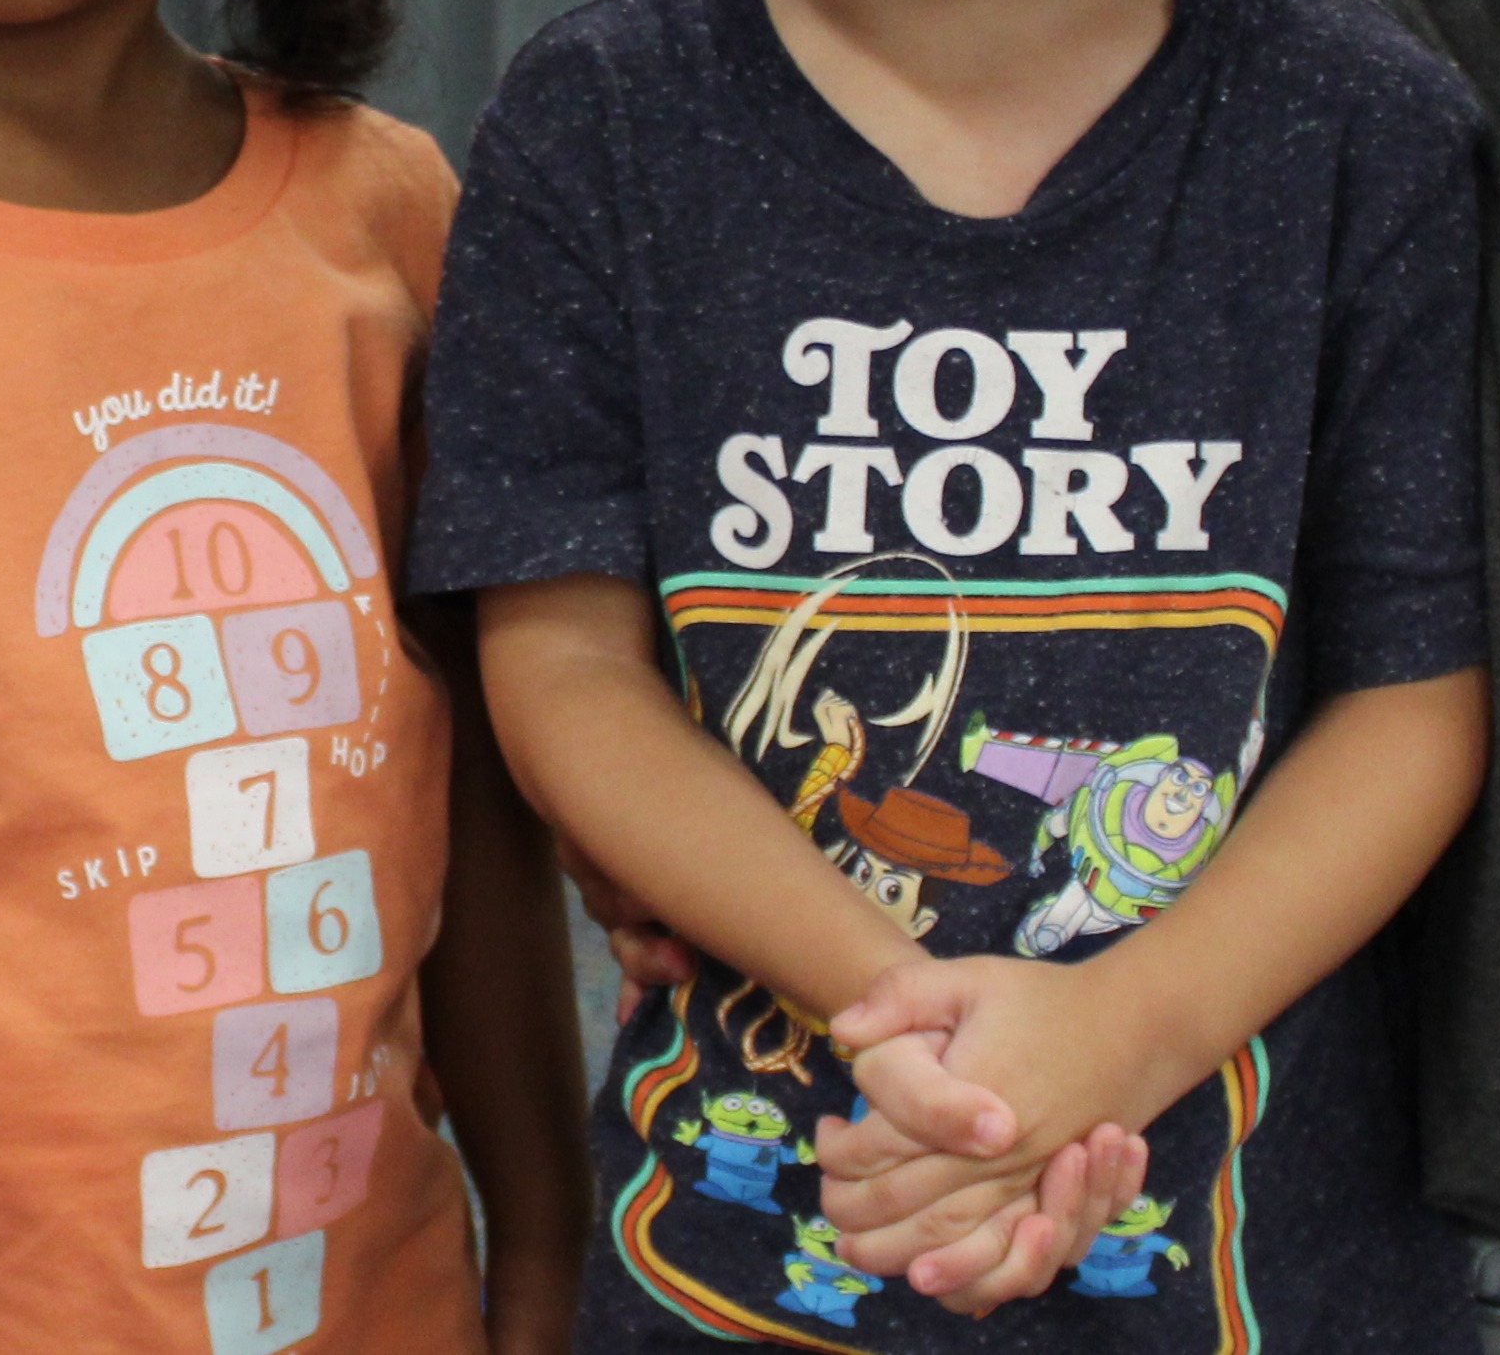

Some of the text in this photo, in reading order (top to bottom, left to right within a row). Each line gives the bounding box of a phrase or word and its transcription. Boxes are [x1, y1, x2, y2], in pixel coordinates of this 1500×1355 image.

[72, 370, 280, 451] you did it!
[782, 317, 1127, 441] TOY
[710, 432, 1243, 569] STORY
[167, 520, 253, 601] 10
[141, 643, 192, 722] 8
[271, 628, 321, 706] 9
[331, 735, 388, 778] HOP
[238, 770, 278, 850] 7
[56, 846, 159, 901] SKIP
[174, 914, 217, 994] 5
[307, 880, 350, 956] 6
[250, 1022, 290, 1099] 4
[186, 1168, 228, 1240] 2
[314, 1136, 341, 1205] 3
[252, 1267, 277, 1334] 1
